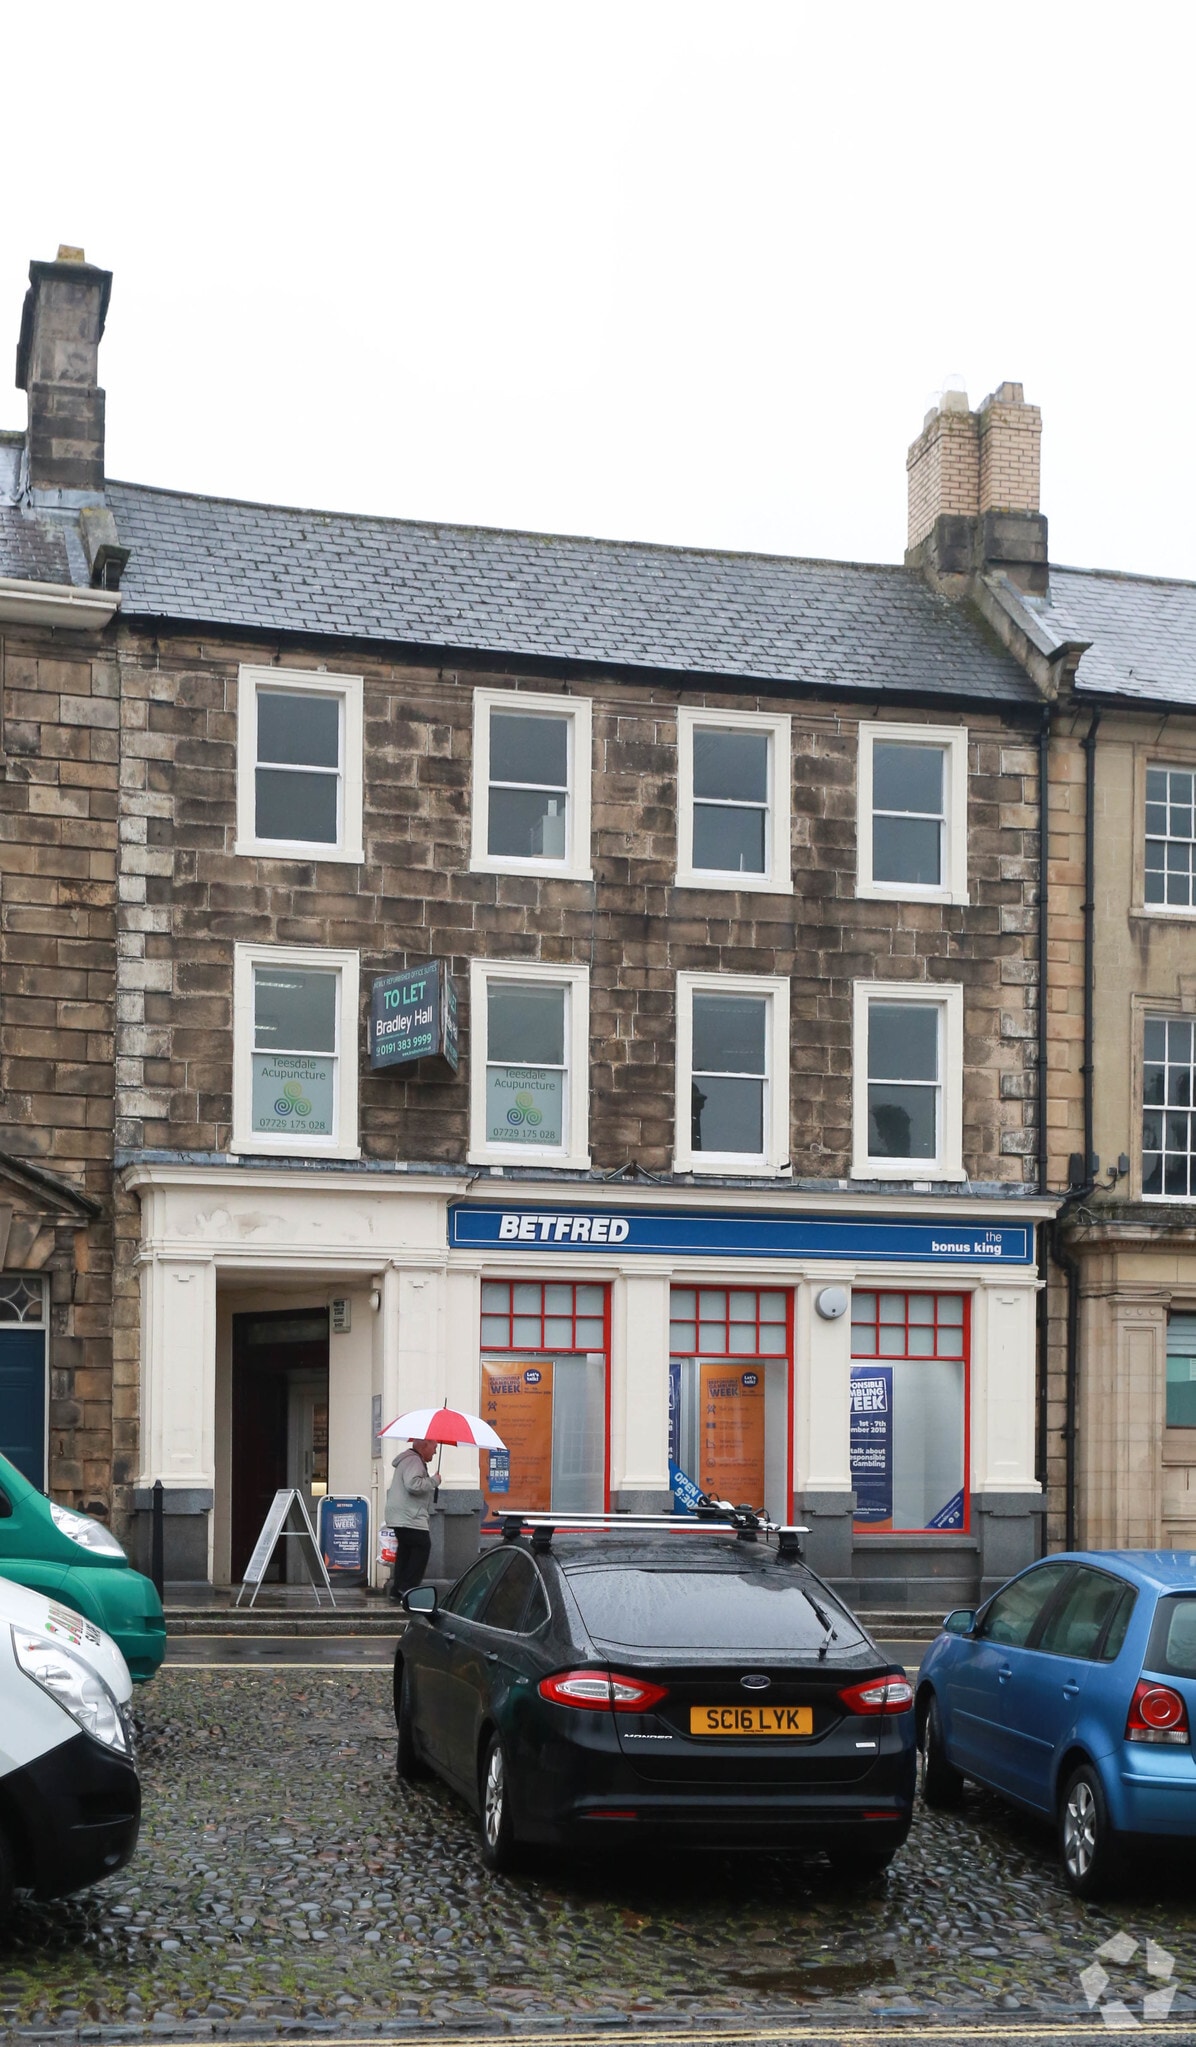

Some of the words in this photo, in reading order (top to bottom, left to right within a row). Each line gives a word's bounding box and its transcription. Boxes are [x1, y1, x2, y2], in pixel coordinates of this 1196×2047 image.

[384, 989, 400, 1009] TO
[403, 981, 427, 1005] LET
[376, 1014, 412, 1036] Bradley
[414, 1005, 433, 1026] Hall
[380, 1042, 396, 1055] 0191
[397, 1038, 411, 1051] 383
[412, 1033, 432, 1047] 9999
[272, 1057, 317, 1069] Teesdale
[261, 1067, 326, 1080] Acupuncture
[505, 1068, 546, 1079] Teesdale
[494, 1079, 556, 1090] Acupuncture
[260, 1118, 287, 1127] 07729
[290, 1120, 306, 1129] 175
[308, 1121, 325, 1130] 028
[493, 1128, 519, 1137] 07729
[522, 1130, 537, 1138] 175
[540, 1131, 556, 1139] 028
[498, 1215, 630, 1242] BETFRED
[985, 1231, 1002, 1242] the
[931, 1241, 971, 1252] bonus
[974, 1242, 1002, 1255] king
[491, 1386, 521, 1394] WEEK
[850, 1381, 884, 1389] ONSIBLE
[710, 1388, 739, 1397] WEEK
[850, 1396, 886, 1411] EEK
[852, 1460, 886, 1468] Gambling
[674, 1472, 699, 1498] OPEN
[334, 1521, 355, 1529] WEEK
[707, 1709, 753, 1730] SC16
[759, 1709, 800, 1730] LYK
